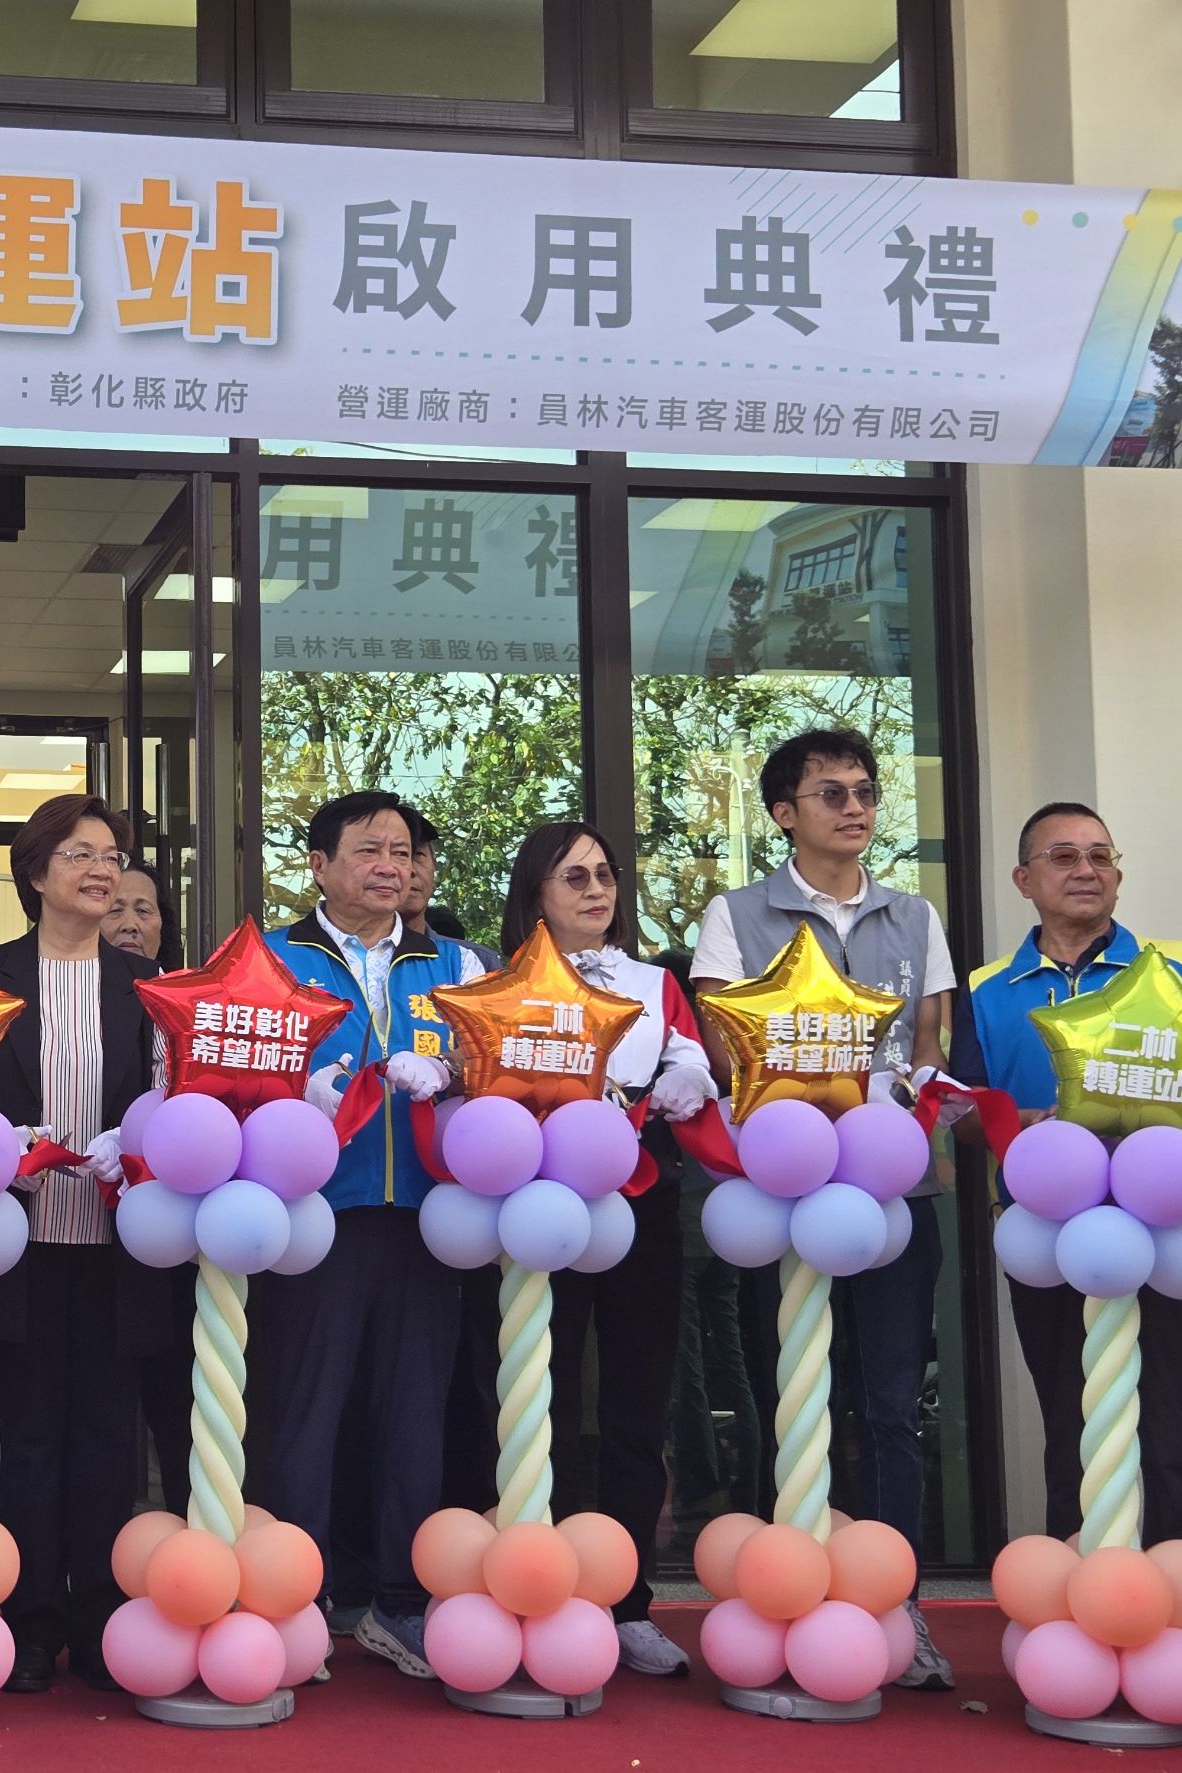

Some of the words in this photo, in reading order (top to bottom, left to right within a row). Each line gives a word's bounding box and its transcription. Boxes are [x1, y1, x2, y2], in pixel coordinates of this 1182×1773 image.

[331, 199, 1002, 347] 啟用典禮
[193, 1001, 310, 1042] 美好彰化
[518, 998, 586, 1037] 二林
[766, 1012, 876, 1042] 美好彰化
[191, 1033, 306, 1074] 希望城市
[499, 1035, 596, 1076] 轉運站
[765, 1043, 875, 1073] 希望城市
[1103, 1021, 1178, 1061] 二林
